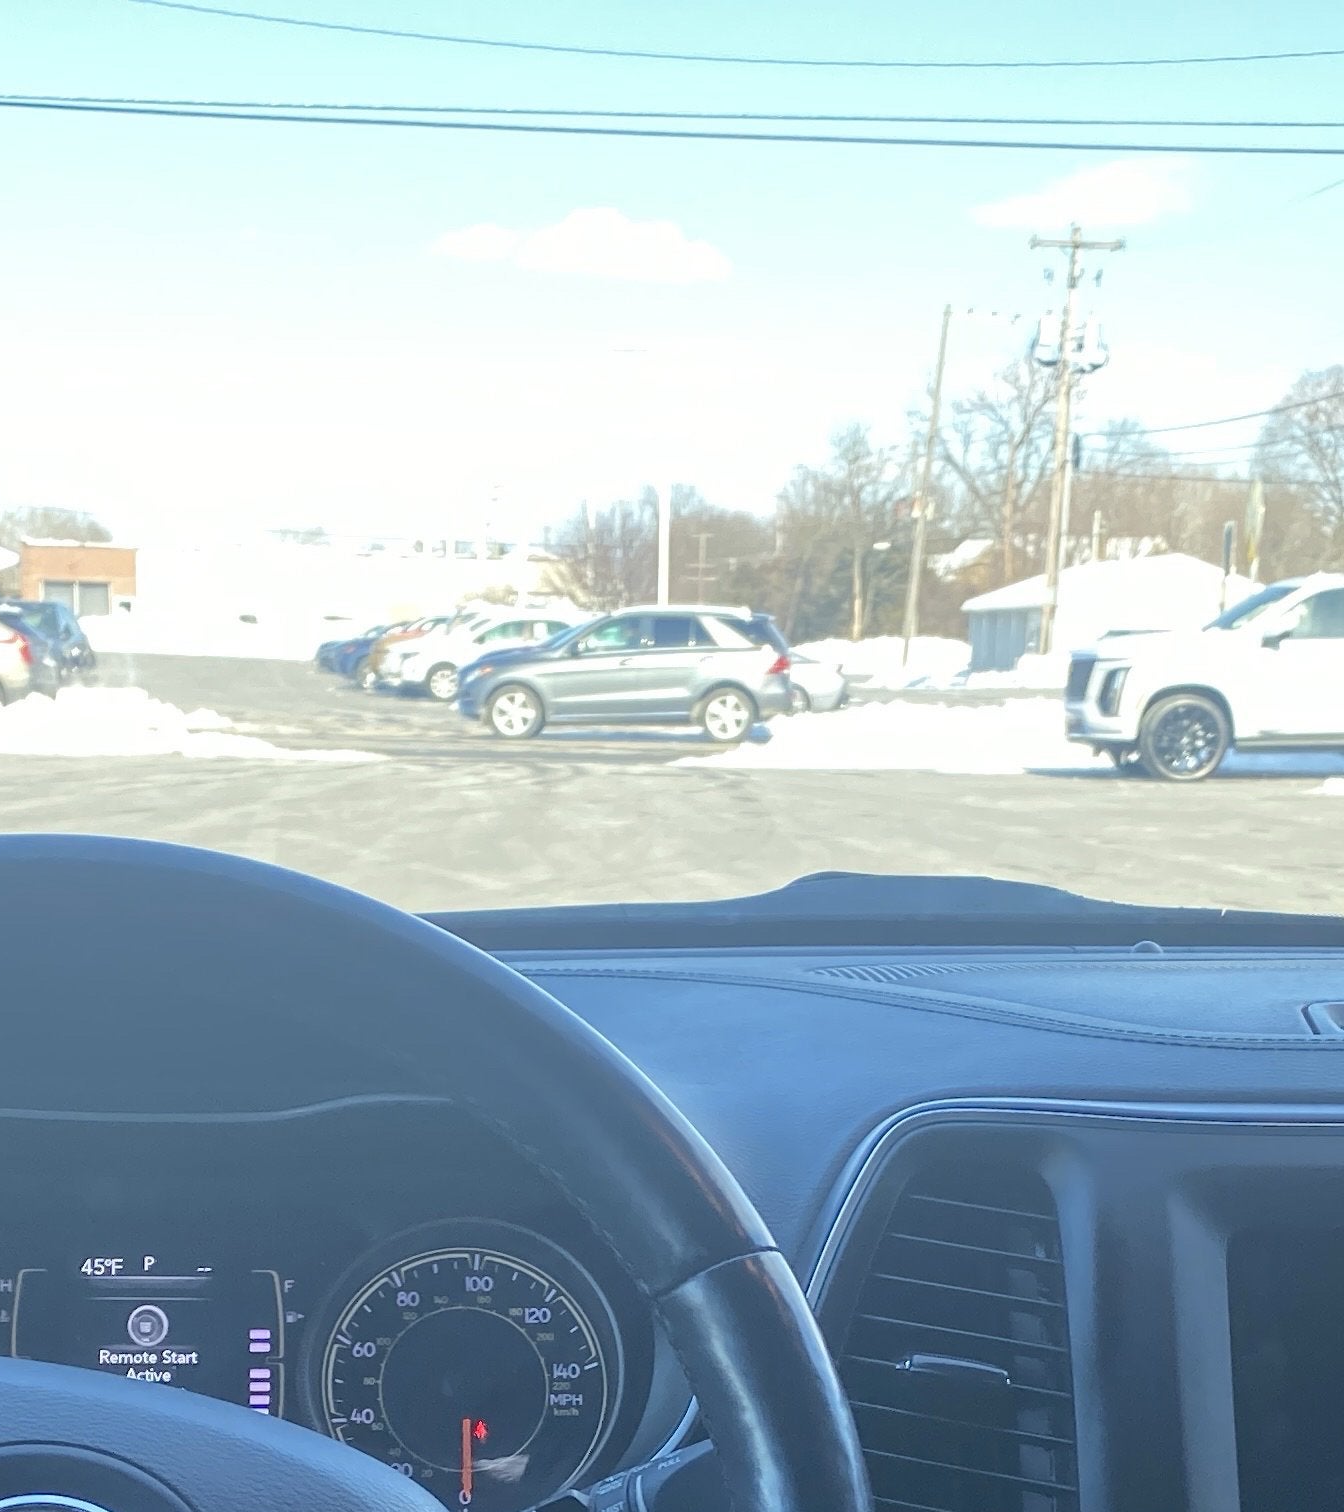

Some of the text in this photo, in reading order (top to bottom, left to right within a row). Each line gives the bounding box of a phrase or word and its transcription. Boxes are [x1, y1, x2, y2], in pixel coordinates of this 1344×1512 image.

[143, 1255, 155, 1271] P
[0, 1279, 13, 1293] H
[284, 1279, 295, 1293] F
[465, 1276, 493, 1292] 100
[396, 1291, 420, 1307] 80
[524, 1307, 551, 1324] 120
[99, 1350, 198, 1365] Remote Start
[352, 1342, 376, 1358] 60
[126, 1367, 172, 1382] Active
[552, 1363, 580, 1379] 140
[549, 1393, 583, 1406] MPH
[350, 1408, 375, 1424] 40
